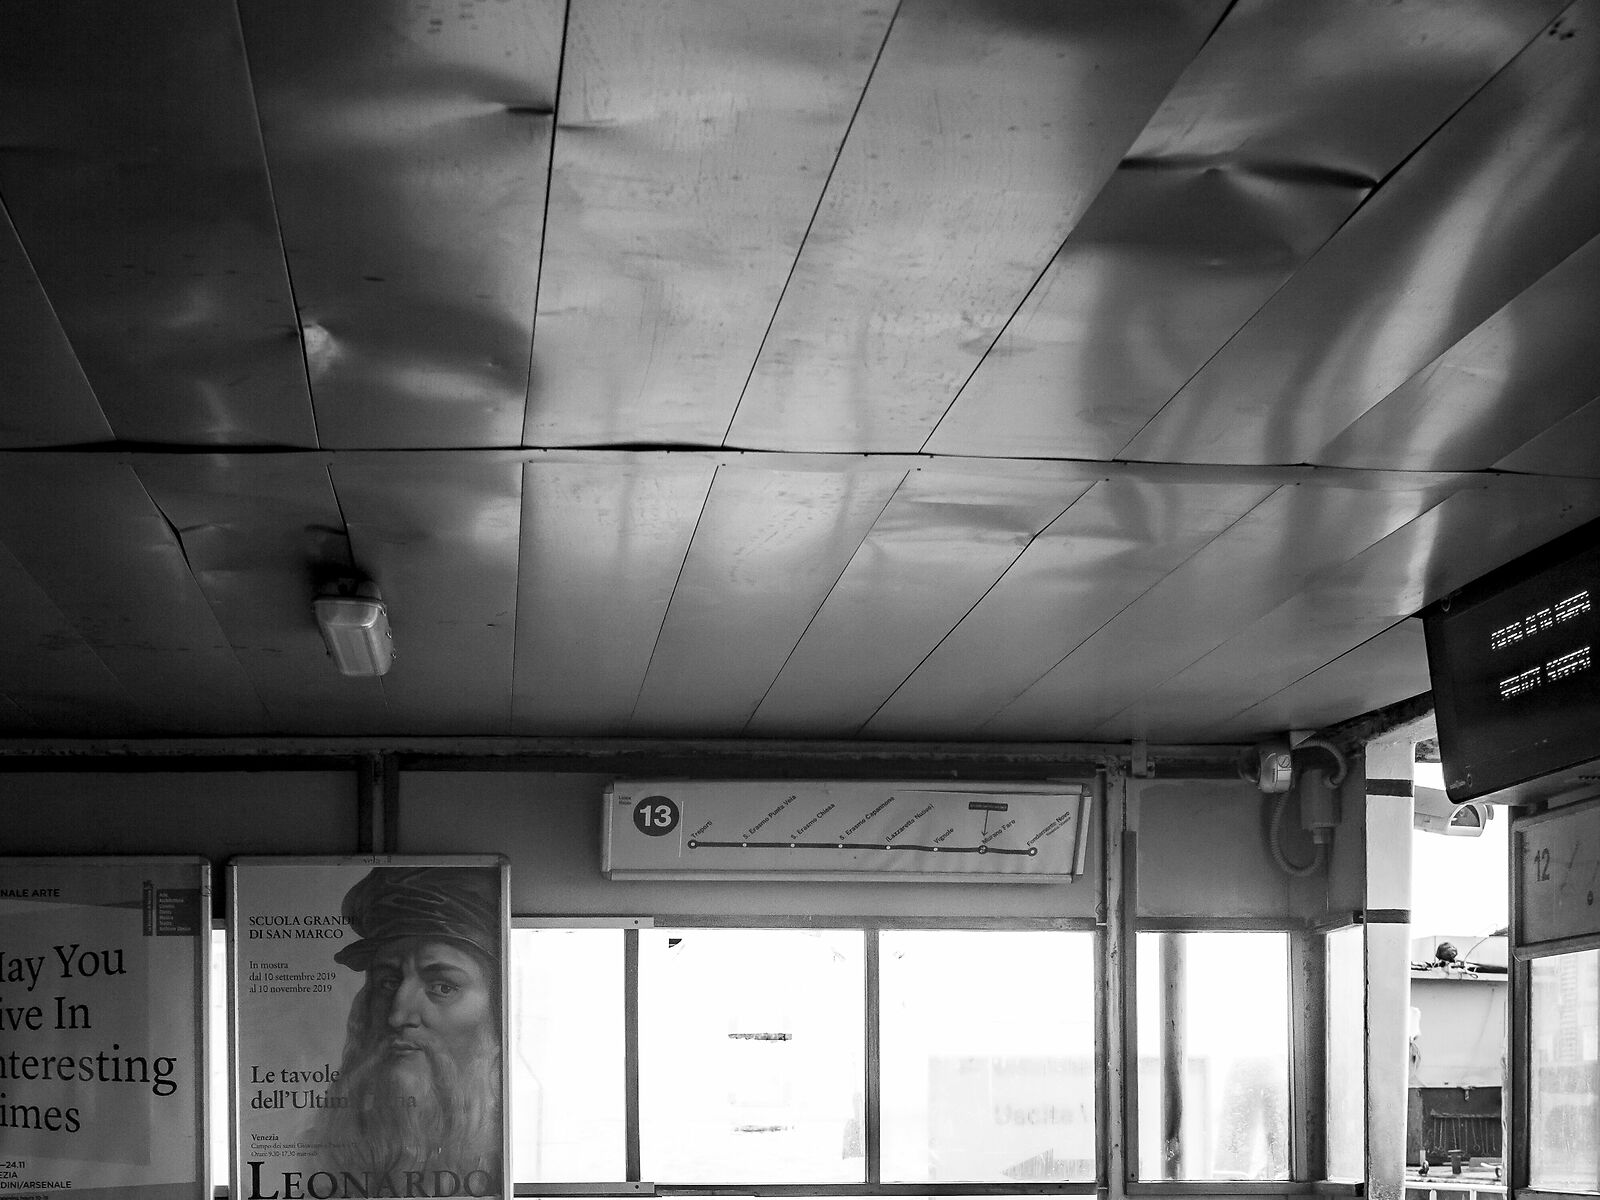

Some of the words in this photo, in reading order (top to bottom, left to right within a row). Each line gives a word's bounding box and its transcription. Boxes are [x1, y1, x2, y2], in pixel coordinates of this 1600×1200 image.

[639, 804, 672, 828] 13
[749, 817, 770, 834] Erasmo
[797, 817, 818, 835] Erasmo
[816, 803, 836, 819] Chiesa
[845, 818, 866, 836] Erasmo
[865, 796, 895, 820] Capannone
[1001, 819, 1016, 831] Faro
[1534, 847, 1550, 882] 12
[32, 888, 60, 898] ARTE
[249, 915, 301, 926] SCUOLA
[249, 929, 263, 939] DI
[266, 929, 292, 939] SAN
[295, 929, 344, 939] MARCO
[0, 951, 45, 991] ay
[53, 944, 126, 978] You
[249, 960, 259, 969] In
[260, 960, 289, 969] mostra
[249, 972, 262, 981] dal
[264, 972, 274, 981] 10
[275, 972, 315, 981] settembre
[316, 972, 336, 981] 2019
[249, 984, 257, 993] al
[259, 984, 269, 993] 10
[270, 984, 311, 993] novembre
[313, 984, 332, 993] 2019
[54, 996, 92, 1030] In
[250, 1065, 276, 1084] Le
[280, 1063, 341, 1084] tavole
[250, 1089, 357, 1110] dell'Ultim
[251, 1133, 279, 1141] Venezia
[247, 1160, 493, 1200] LEONARDO
